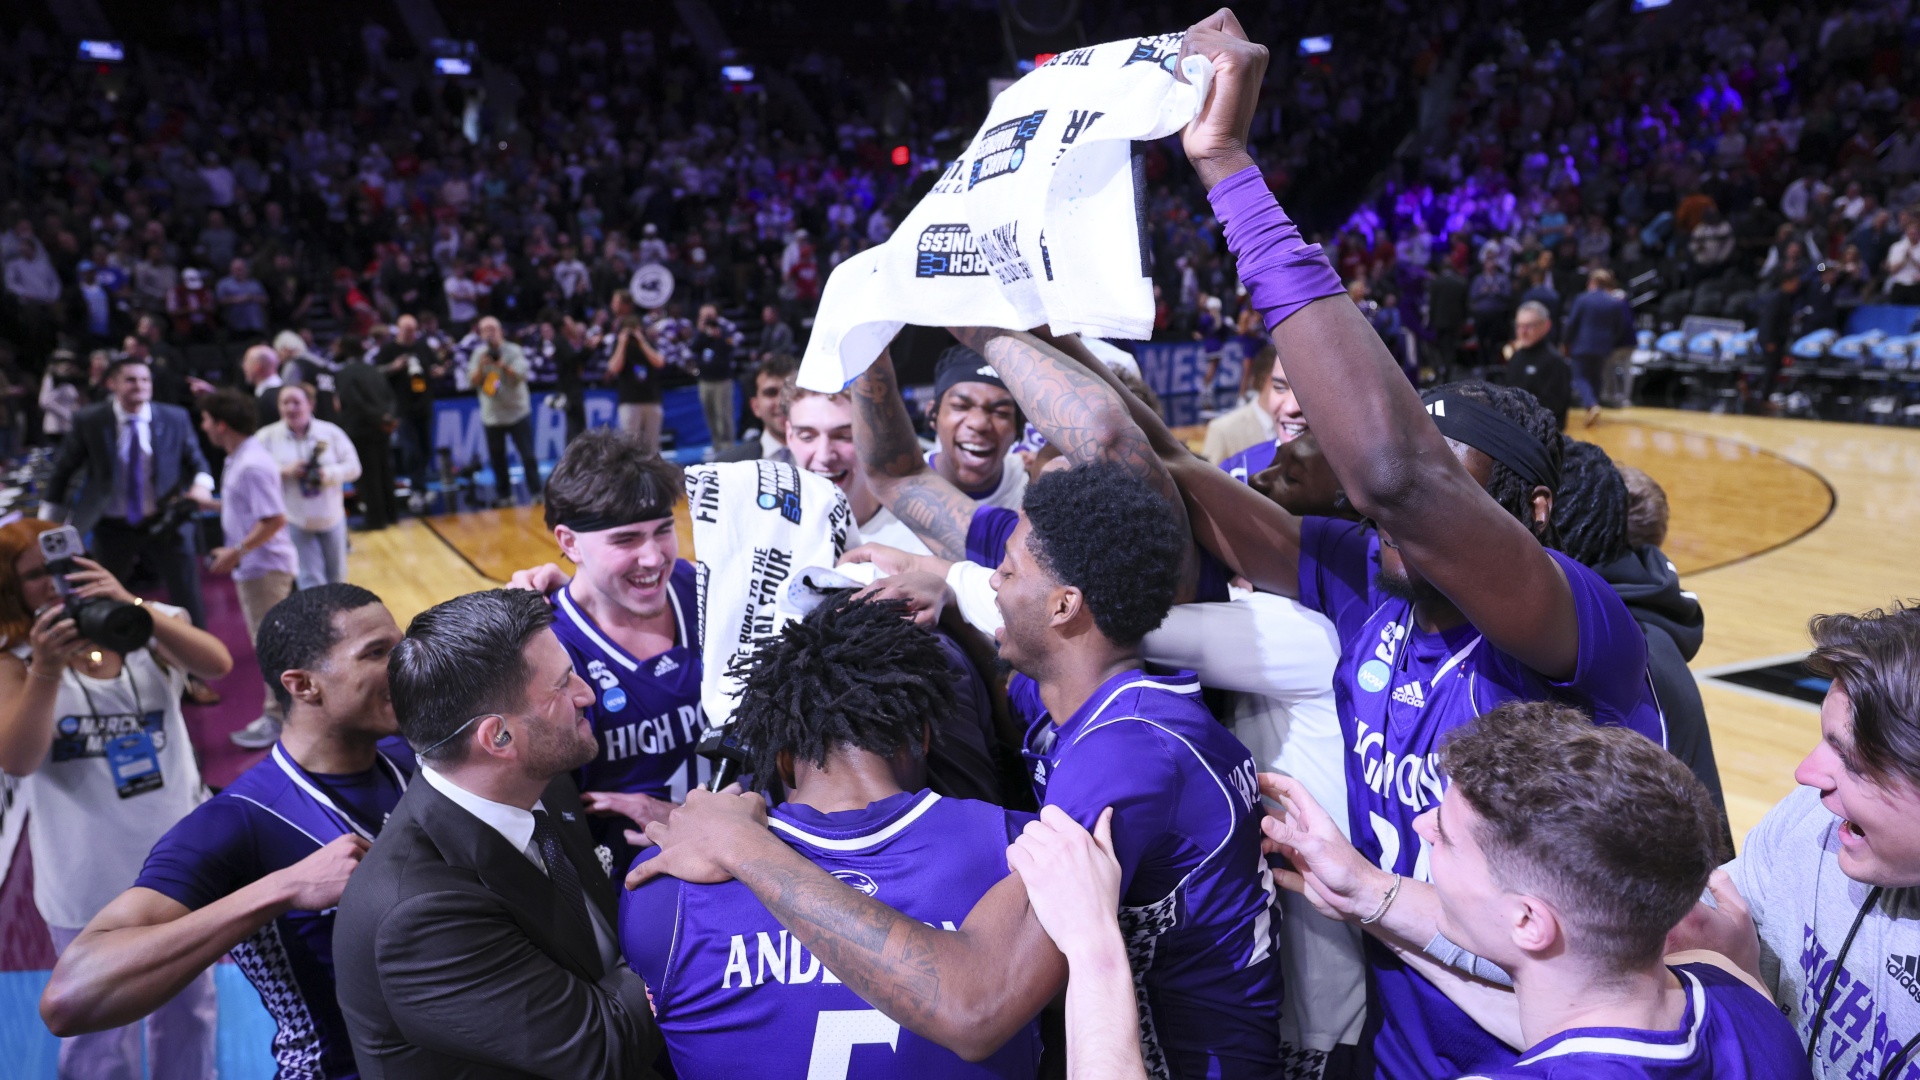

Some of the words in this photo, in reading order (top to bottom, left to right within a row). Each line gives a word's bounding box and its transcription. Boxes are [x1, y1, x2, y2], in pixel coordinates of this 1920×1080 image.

[752, 546, 768, 574] THE
[748, 578, 760, 599] TO
[1391, 691, 1426, 708] adidas
[604, 713, 677, 761] HIGH
